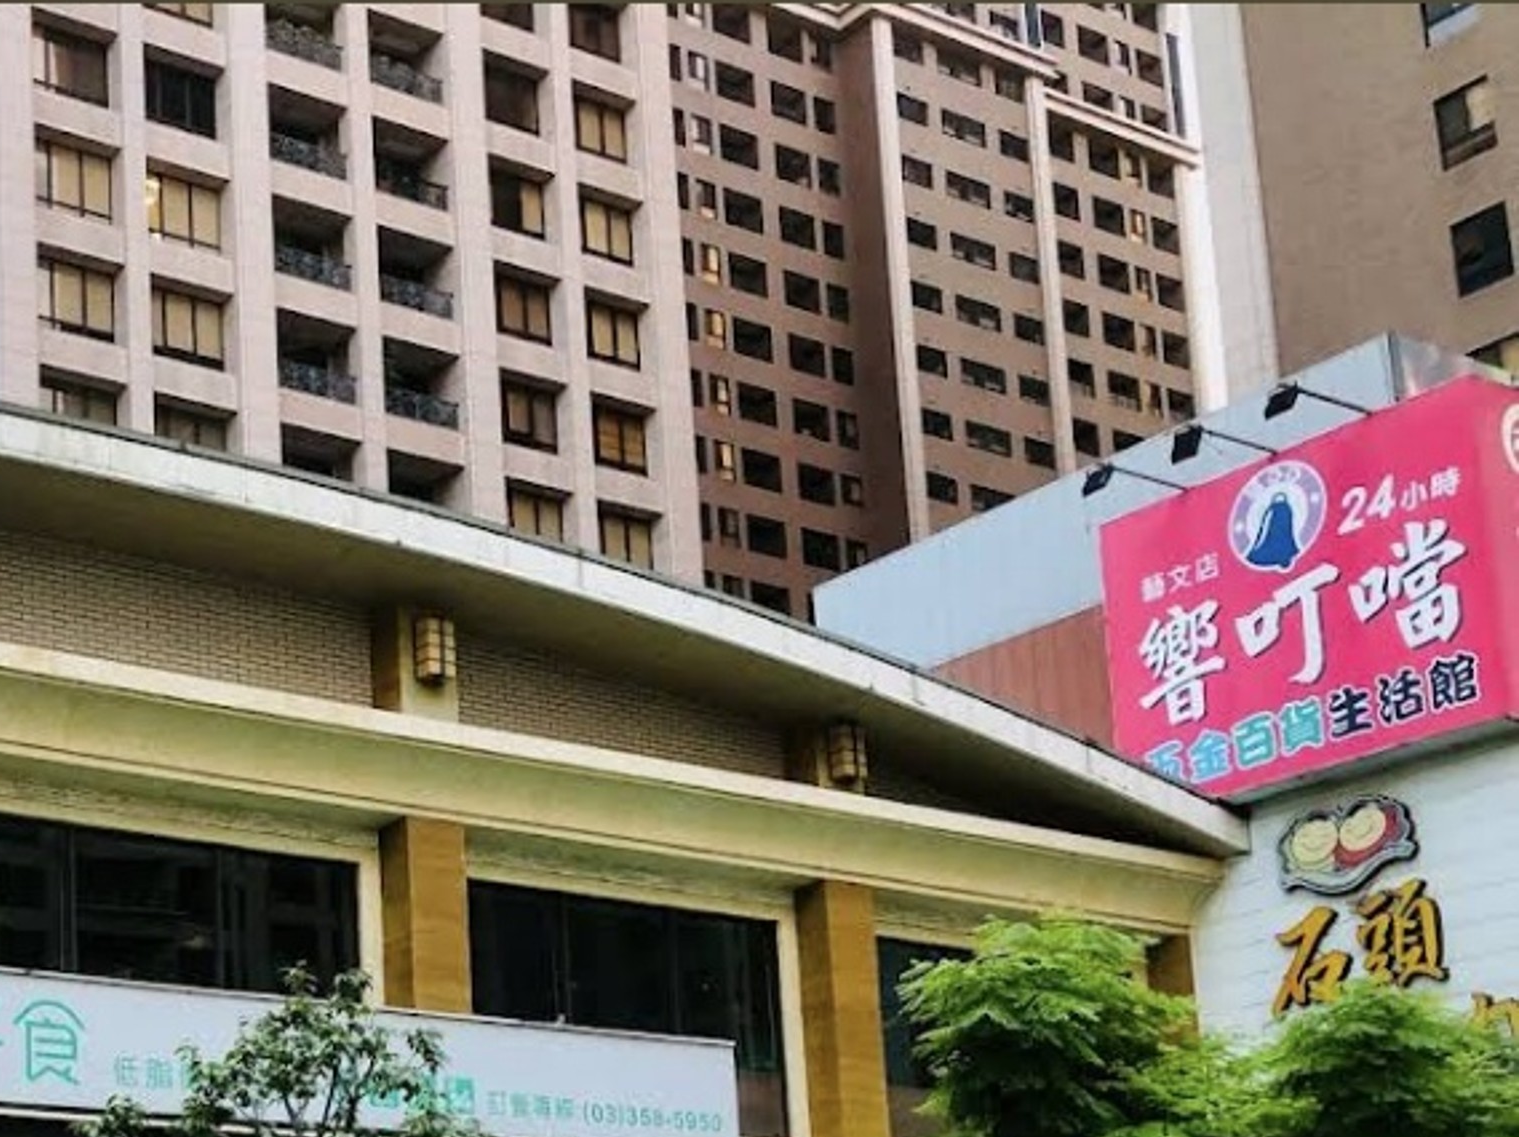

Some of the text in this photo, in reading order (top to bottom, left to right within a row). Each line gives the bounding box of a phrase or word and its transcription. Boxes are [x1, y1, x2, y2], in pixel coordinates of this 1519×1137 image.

[1337, 467, 1461, 536] 24小時
[1138, 518, 1467, 727] 響叮噹
[1139, 552, 1220, 603] 藝文店
[1143, 651, 1480, 786] 五金百貨生活館
[1273, 878, 1449, 1018] 石頭
